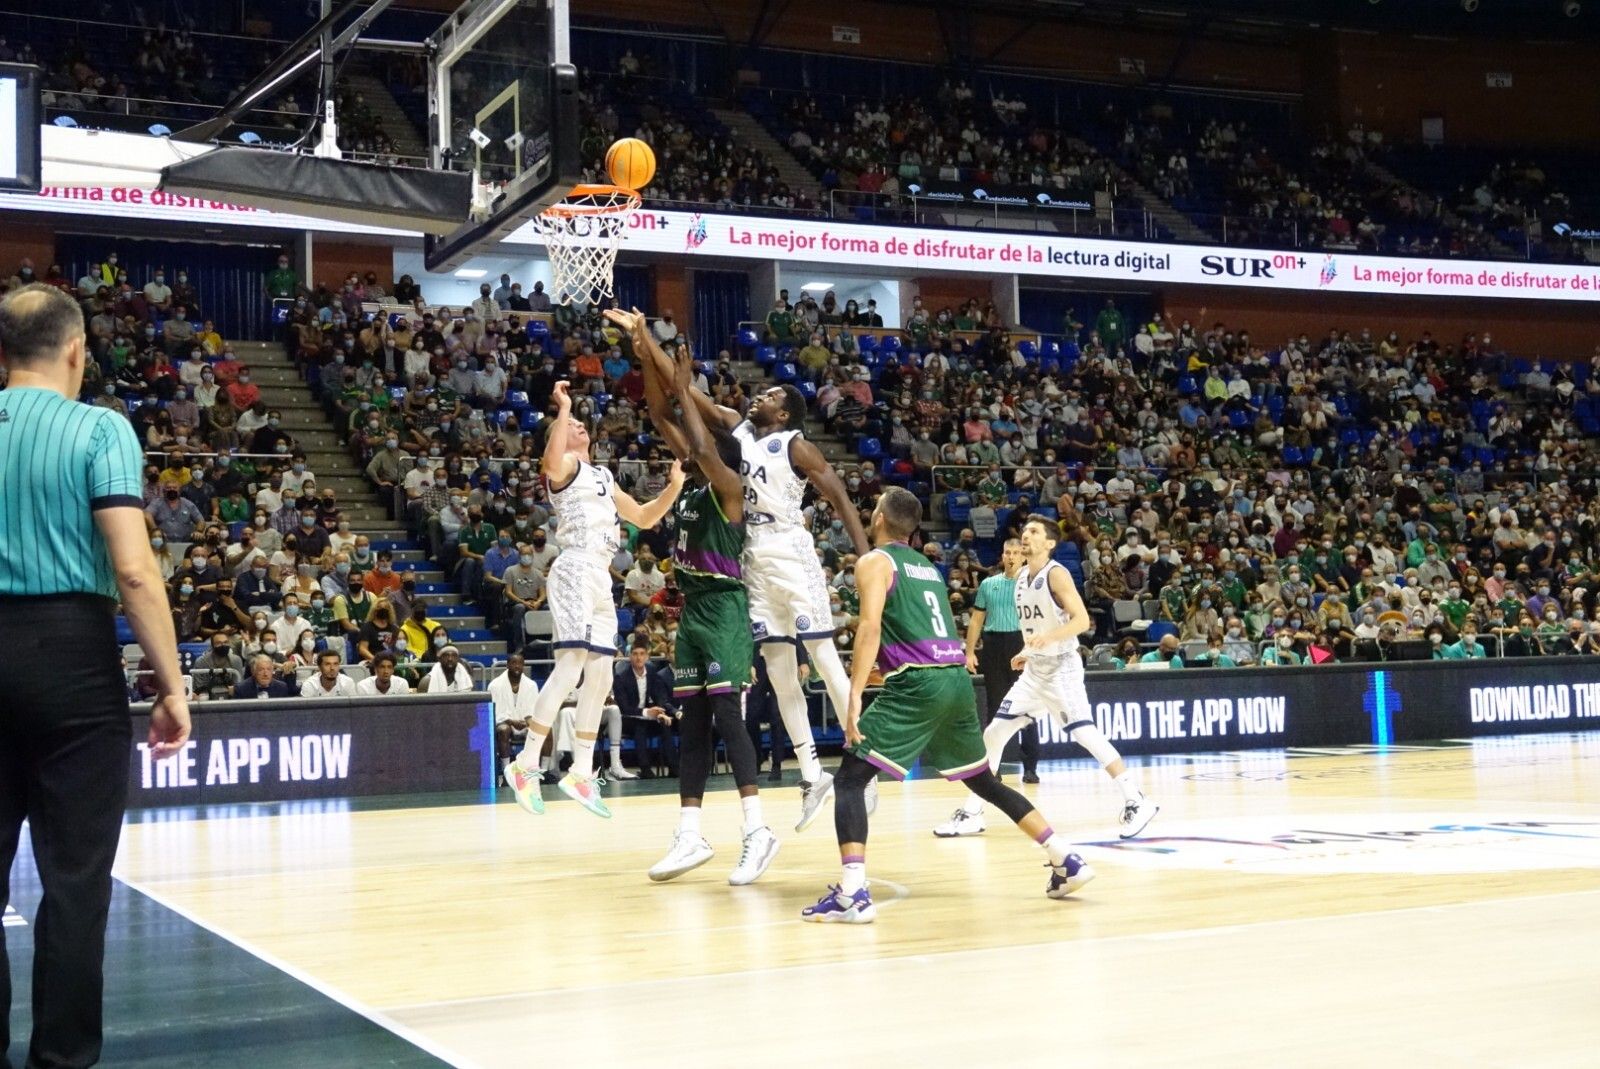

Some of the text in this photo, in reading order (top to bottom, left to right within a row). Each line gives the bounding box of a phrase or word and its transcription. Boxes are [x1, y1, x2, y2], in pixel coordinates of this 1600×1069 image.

[729, 226, 1170, 273] La mejor forma de disfrutar de la lectura digital
[1354, 265, 1372, 281] La
[1376, 266, 1423, 287] mejor
[1427, 268, 1474, 286] forma
[1478, 270, 1497, 287] de
[1501, 271, 1567, 290] disfrutar
[1570, 274, 1590, 290] de
[740, 460, 767, 485] DA
[923, 590, 948, 638] 3
[1146, 700, 1187, 739] THE
[1190, 698, 1234, 737] APP
[1237, 696, 1286, 735] NOW
[1470, 684, 1570, 723] DOWNLOAD
[136, 733, 352, 789] THE APP NOW
